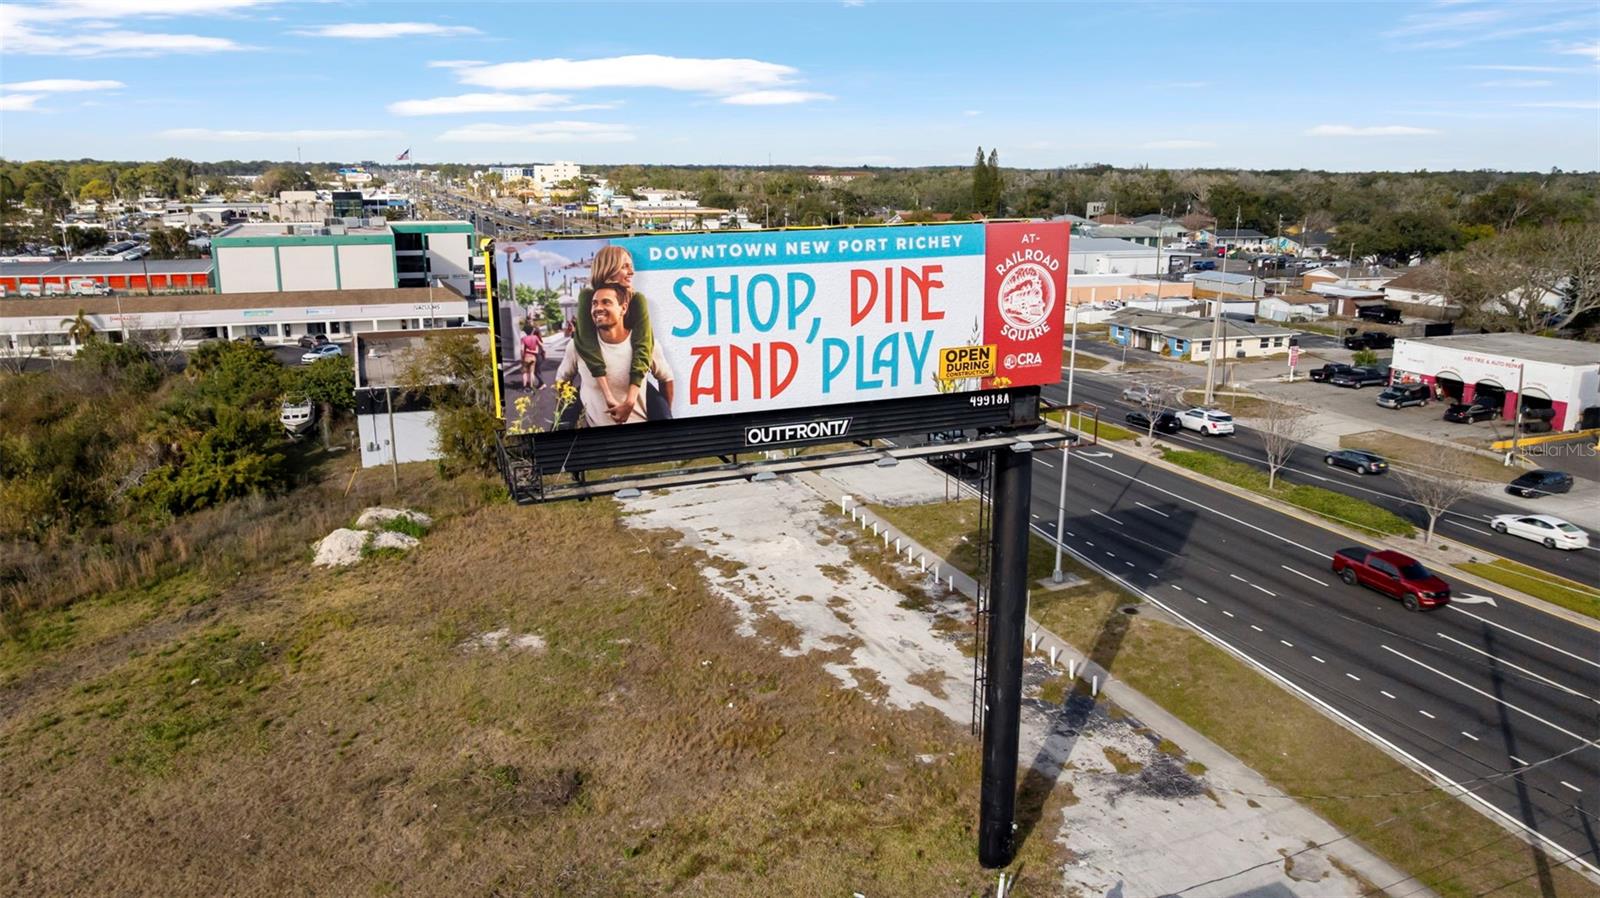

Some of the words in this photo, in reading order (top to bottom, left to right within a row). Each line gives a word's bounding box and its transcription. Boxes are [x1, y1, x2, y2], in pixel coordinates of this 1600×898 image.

[650, 242, 777, 261] DOWNTOWN
[785, 240, 830, 256] NEW
[839, 238, 888, 253] PORT
[896, 235, 963, 250] RICHEY
[995, 249, 1060, 276] RAILROAD
[671, 272, 822, 344] SHOP,
[850, 264, 946, 327] DINE
[1000, 321, 1051, 342] SQUARE
[945, 347, 990, 363] OPEN
[1017, 352, 1043, 365] CRA
[689, 341, 799, 405] AND
[822, 330, 935, 394] PLAY
[946, 360, 989, 372] DURING
[946, 369, 990, 378] CONSTRUCTION
[969, 393, 1010, 407] 49918A
